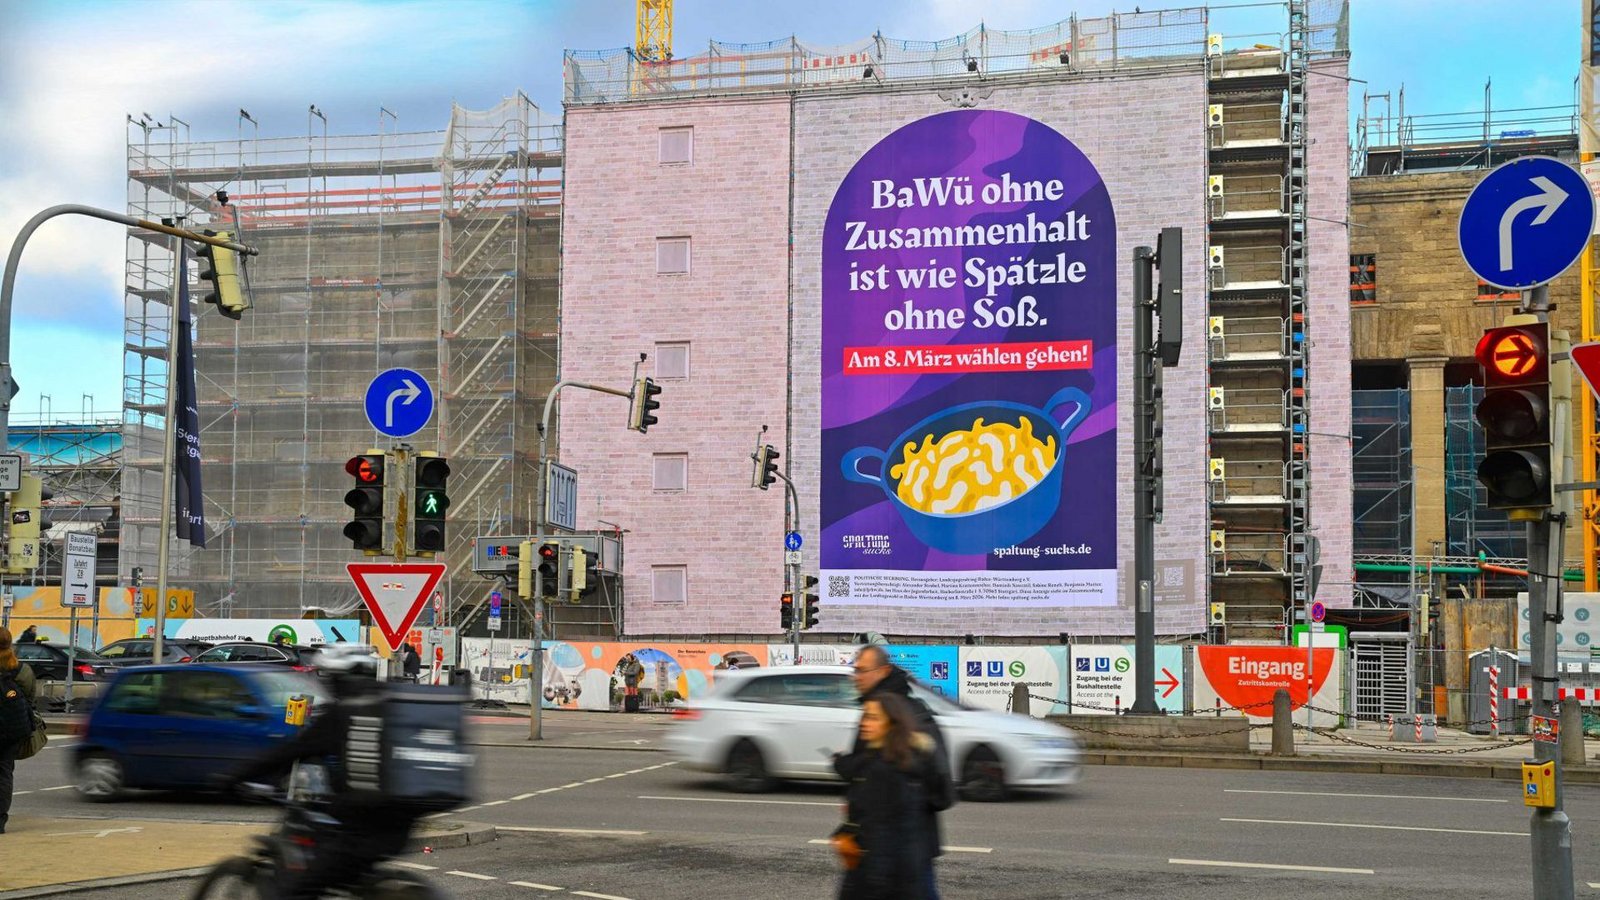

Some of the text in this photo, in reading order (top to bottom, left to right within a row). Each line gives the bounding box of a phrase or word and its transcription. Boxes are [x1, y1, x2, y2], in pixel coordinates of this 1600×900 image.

[871, 172, 1064, 209] BaWü ohne
[844, 210, 1092, 251] Zusammenhalt
[849, 253, 1087, 297] ist wie Spätzle
[884, 295, 1048, 331] ohne Soß.
[848, 344, 1089, 370] Am 8. März wählen gehen!
[993, 543, 1093, 559] spaltung-sucks.de
[1010, 662, 1023, 676] S
[1116, 658, 1128, 672] S
[1229, 656, 1305, 680] Eingang
